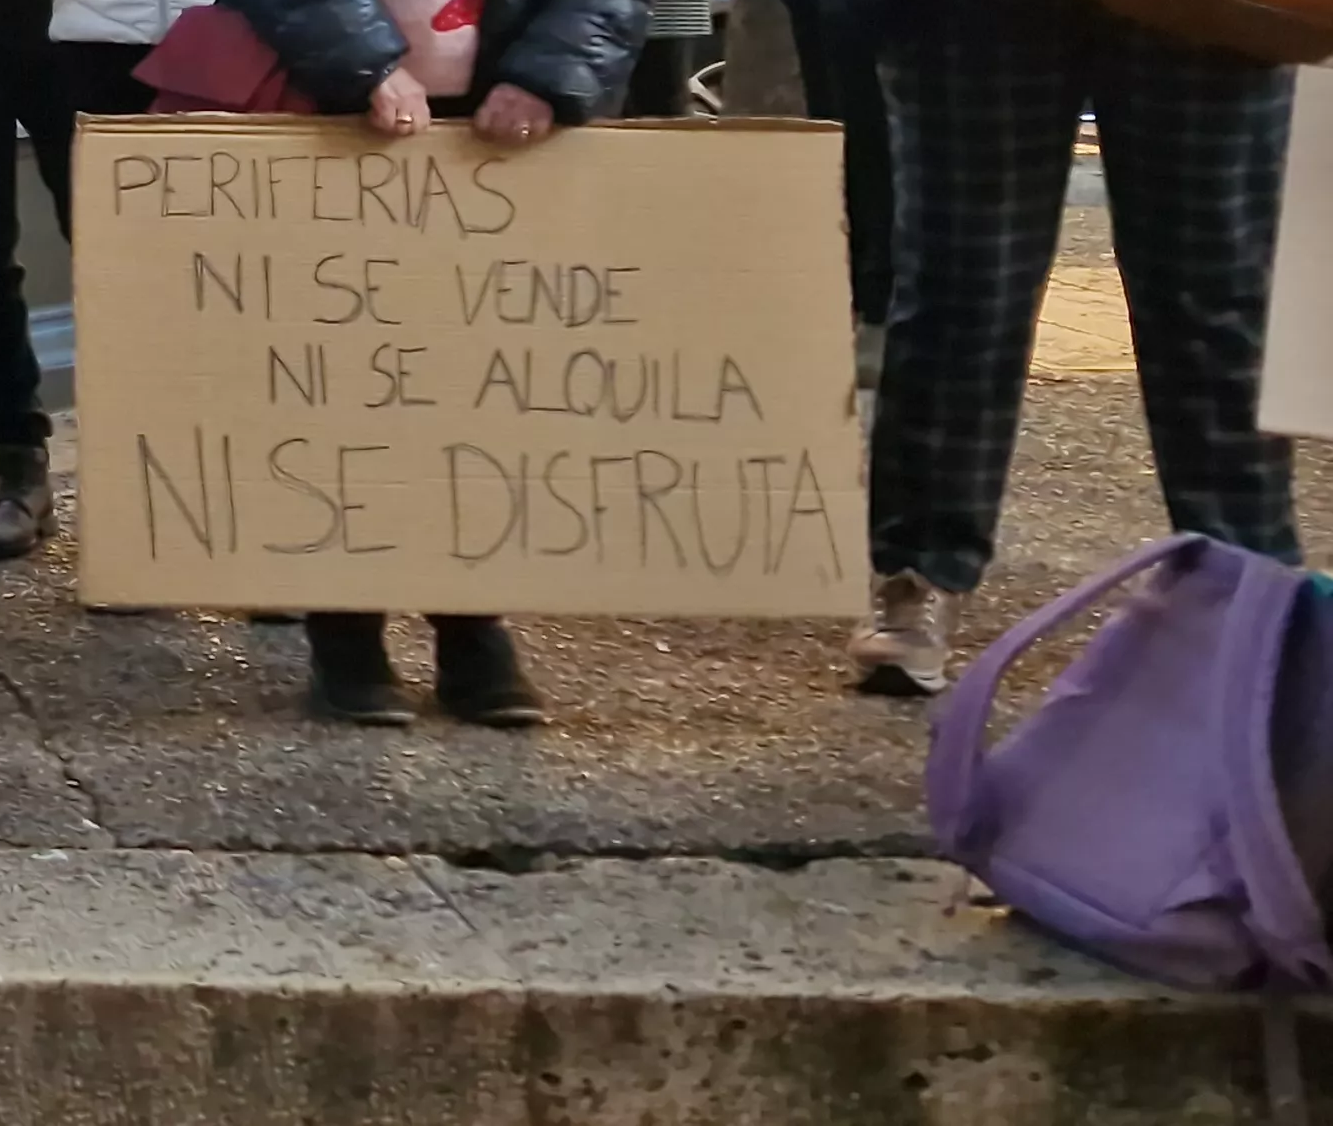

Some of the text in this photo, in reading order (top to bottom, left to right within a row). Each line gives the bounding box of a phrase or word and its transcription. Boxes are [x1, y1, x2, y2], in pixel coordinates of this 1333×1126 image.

[112, 151, 517, 235] PERIFERIAS
[192, 251, 641, 329] NI SE VENDE
[268, 343, 764, 424] NI SE ALQUILA
[137, 426, 843, 581] NI SE DISFRUTA
